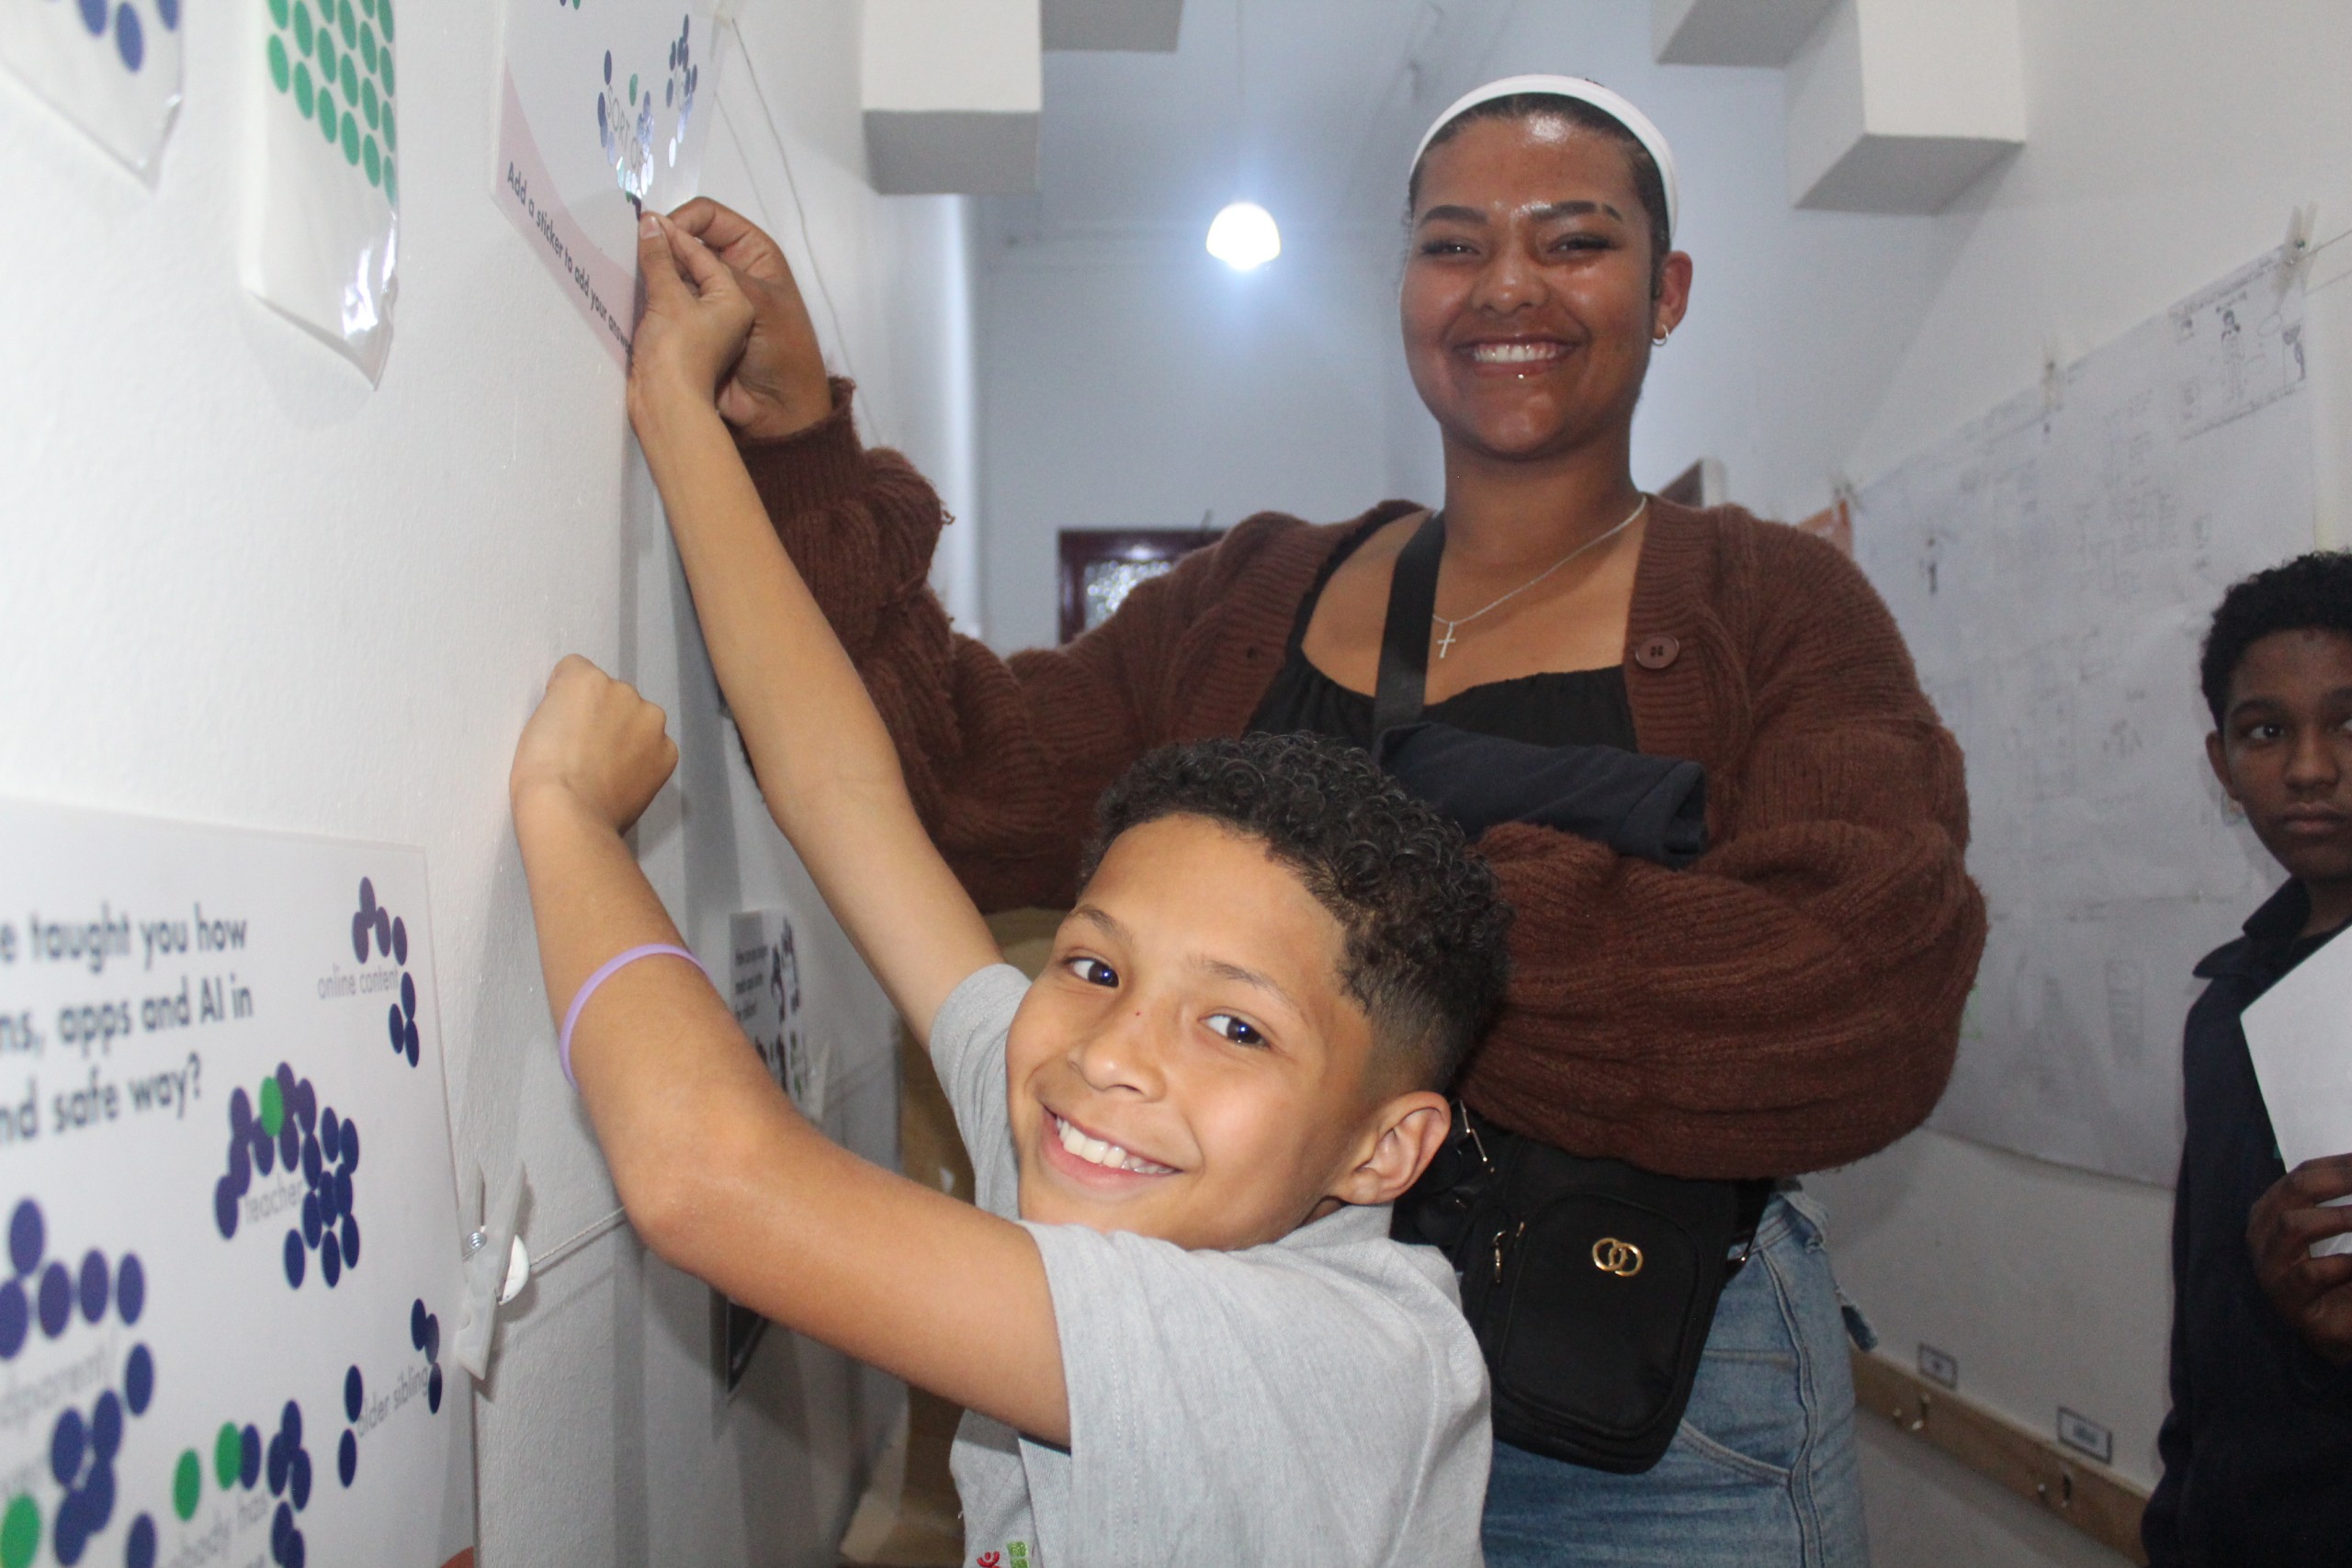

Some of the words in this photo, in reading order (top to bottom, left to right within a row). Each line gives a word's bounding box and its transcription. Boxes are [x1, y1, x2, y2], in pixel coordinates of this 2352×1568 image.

[606, 84, 630, 152] SORT
[507, 161, 527, 207] Add
[528, 197, 535, 218] a
[537, 210, 563, 259] sticker
[564, 247, 573, 274] to
[574, 265, 590, 298] add
[590, 288, 607, 321] your
[608, 313, 632, 355] answe
[28, 901, 130, 975] taught
[140, 919, 188, 971] you
[194, 901, 247, 953] how
[58, 1001, 132, 1057] apps
[141, 976, 190, 1032] and
[199, 976, 224, 1023] AI
[230, 973, 254, 1019] in
[317, 963, 356, 999] online
[359, 963, 398, 994] content
[53, 1063, 119, 1134] safe
[128, 1050, 201, 1120] way?
[357, 1391, 390, 1438] older
[393, 1365, 429, 1410] sibling
